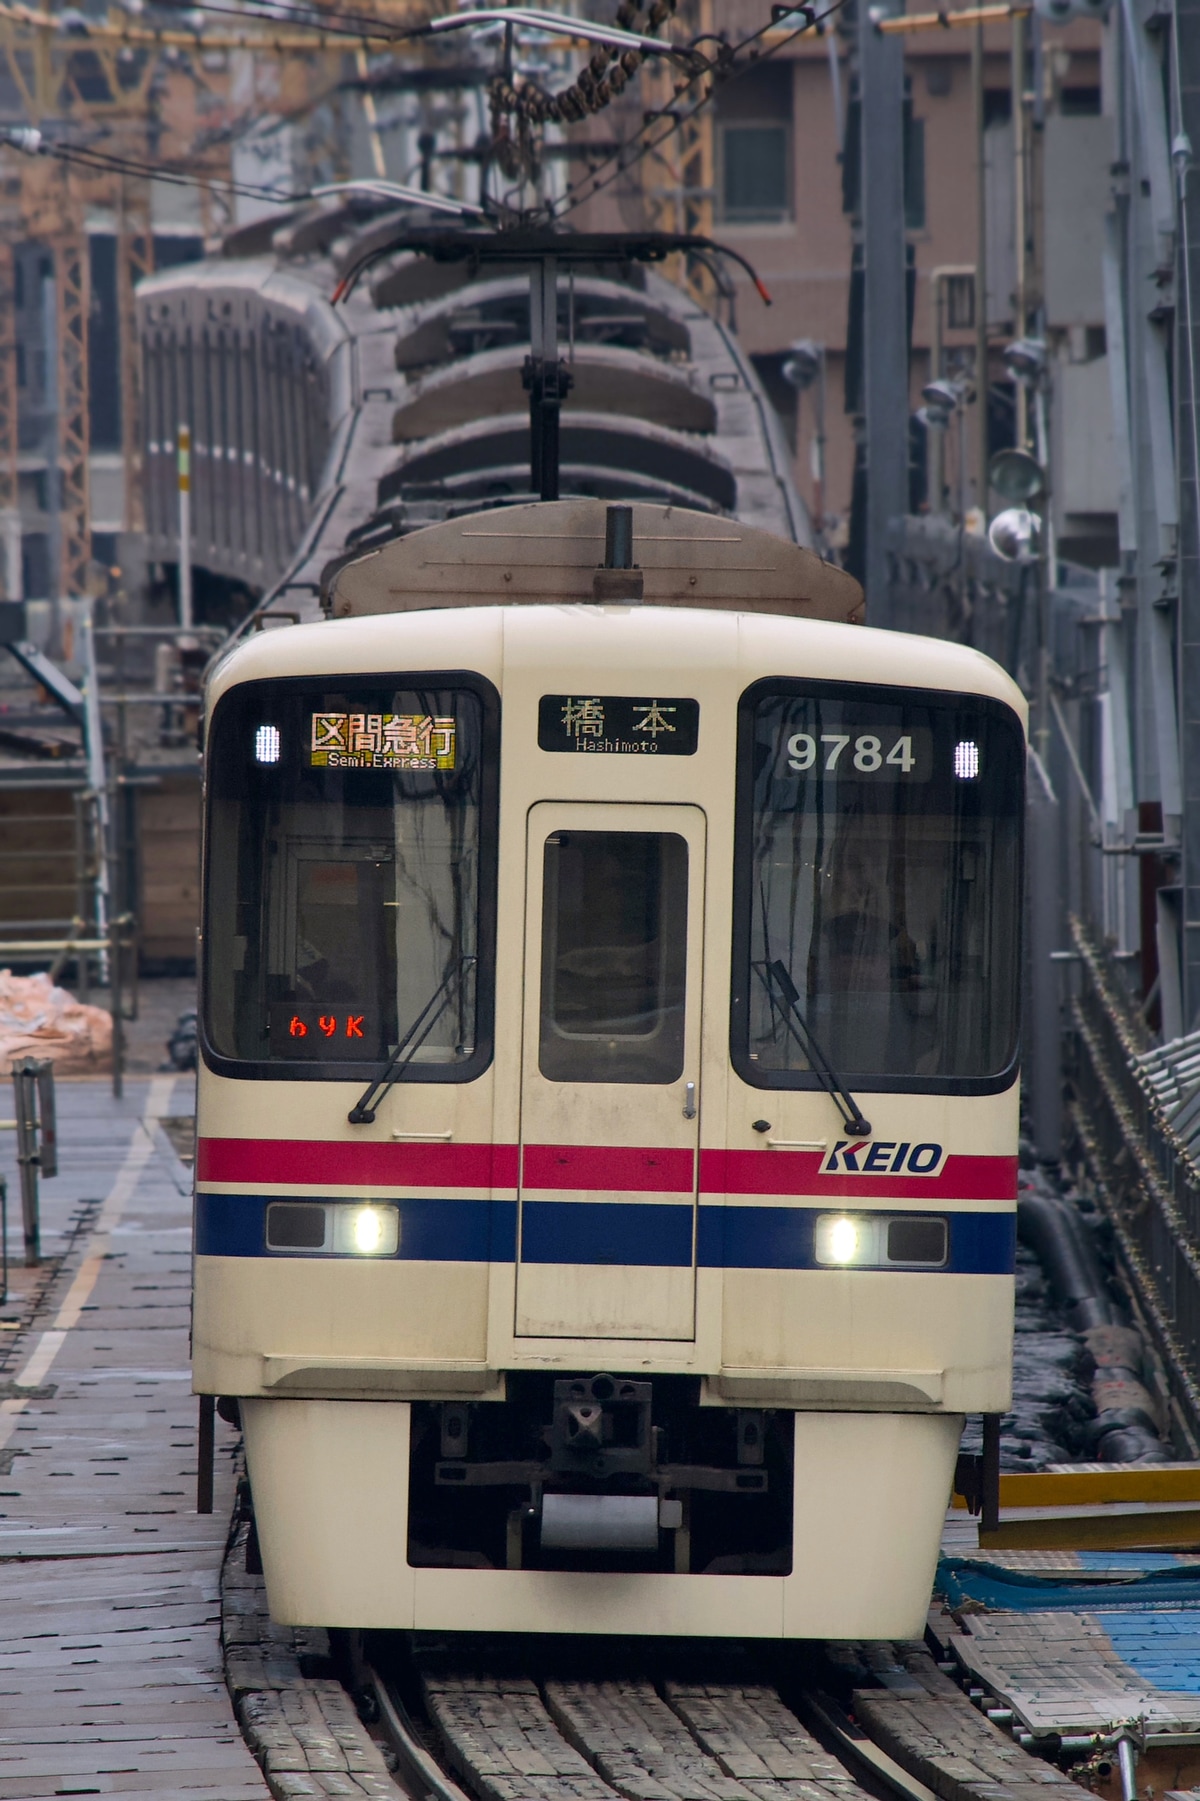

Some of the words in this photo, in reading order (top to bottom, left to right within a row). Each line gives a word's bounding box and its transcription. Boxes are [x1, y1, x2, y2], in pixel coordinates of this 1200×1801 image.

[312, 713, 455, 757] 区間急行
[561, 698, 676, 738] 橋本
[576, 737, 658, 753] Hashimoto
[787, 733, 916, 772] 9784
[826, 1141, 943, 1173] KEIO
